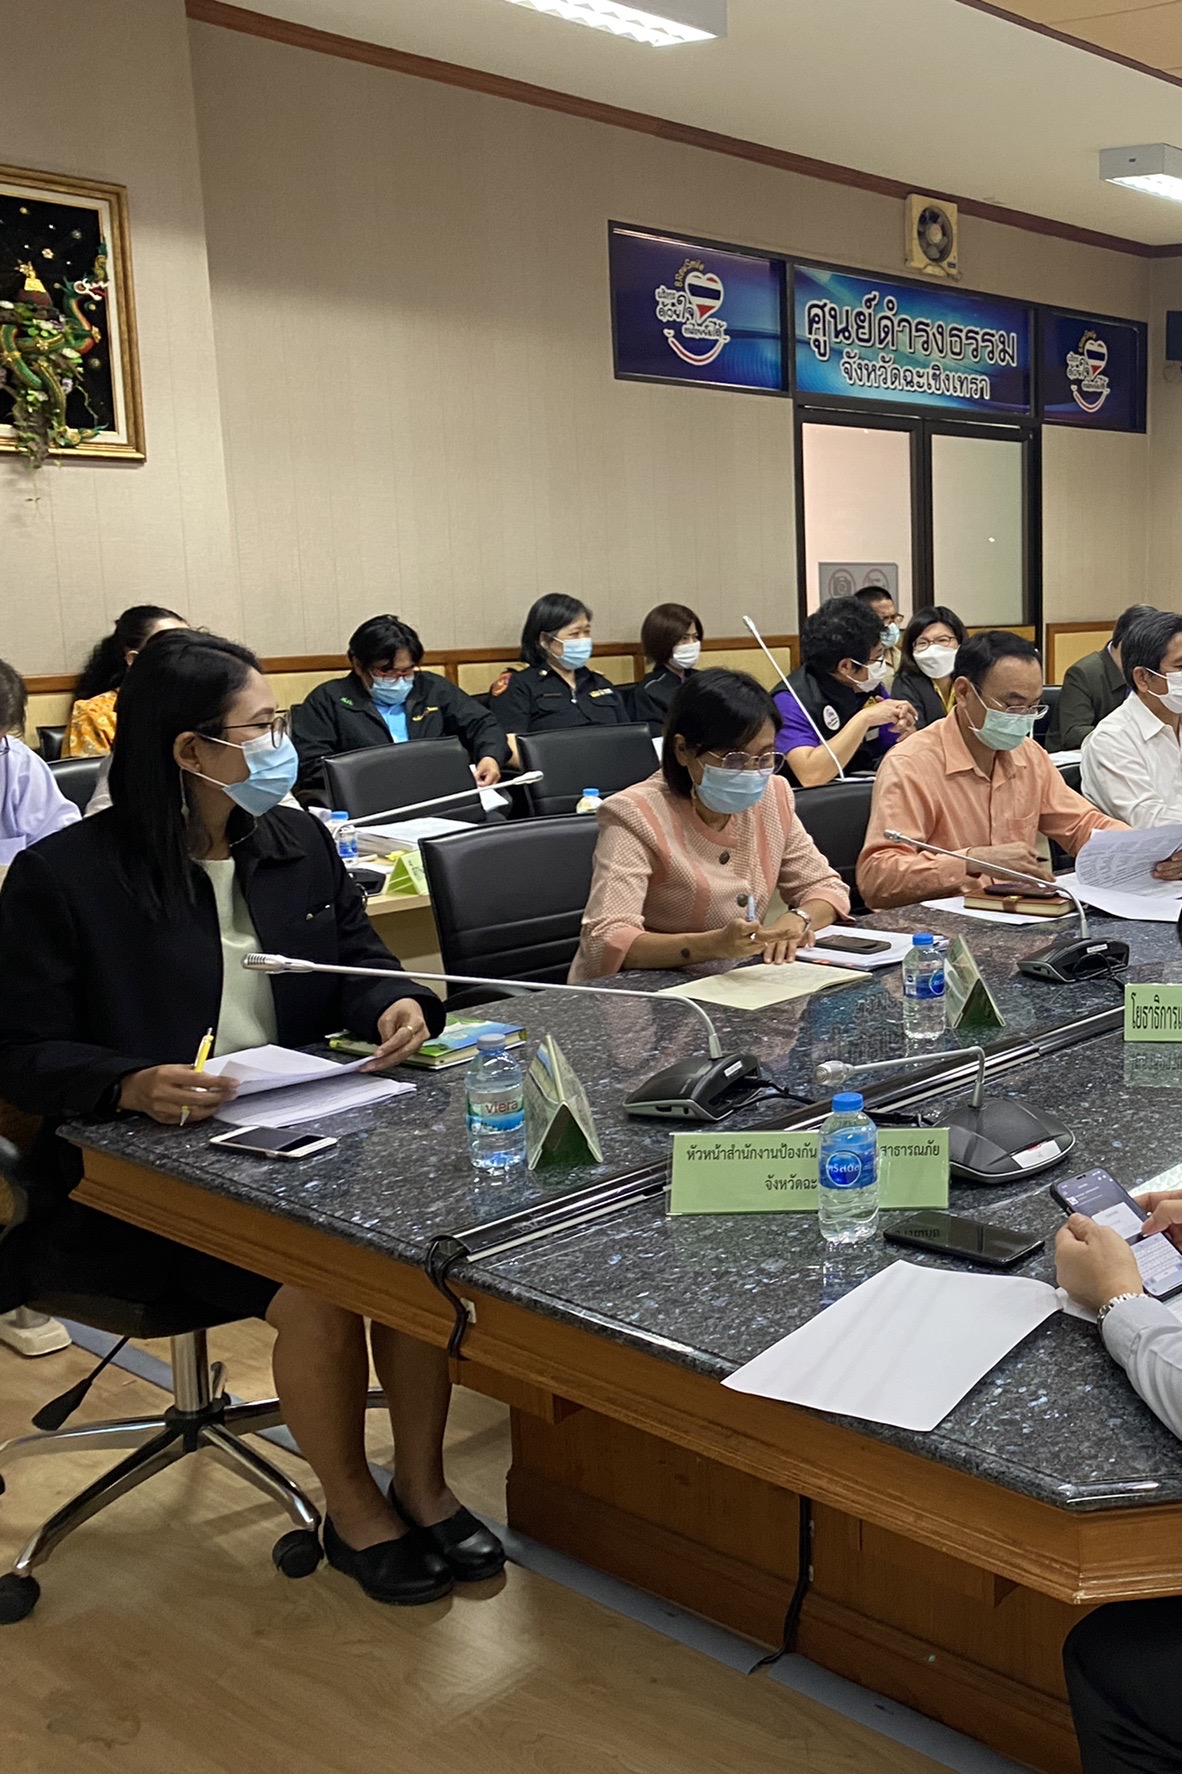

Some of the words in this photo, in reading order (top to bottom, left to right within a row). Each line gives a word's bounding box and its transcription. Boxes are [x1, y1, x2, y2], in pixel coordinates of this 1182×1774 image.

[806, 292, 1017, 366] ศูนย์ดำรงธรรม
[841, 350, 990, 399] จังหวัดฉะเชิงเทรา
[485, 1100, 518, 1114] viera
[764, 1175, 818, 1191] จังหวัดฉะ
